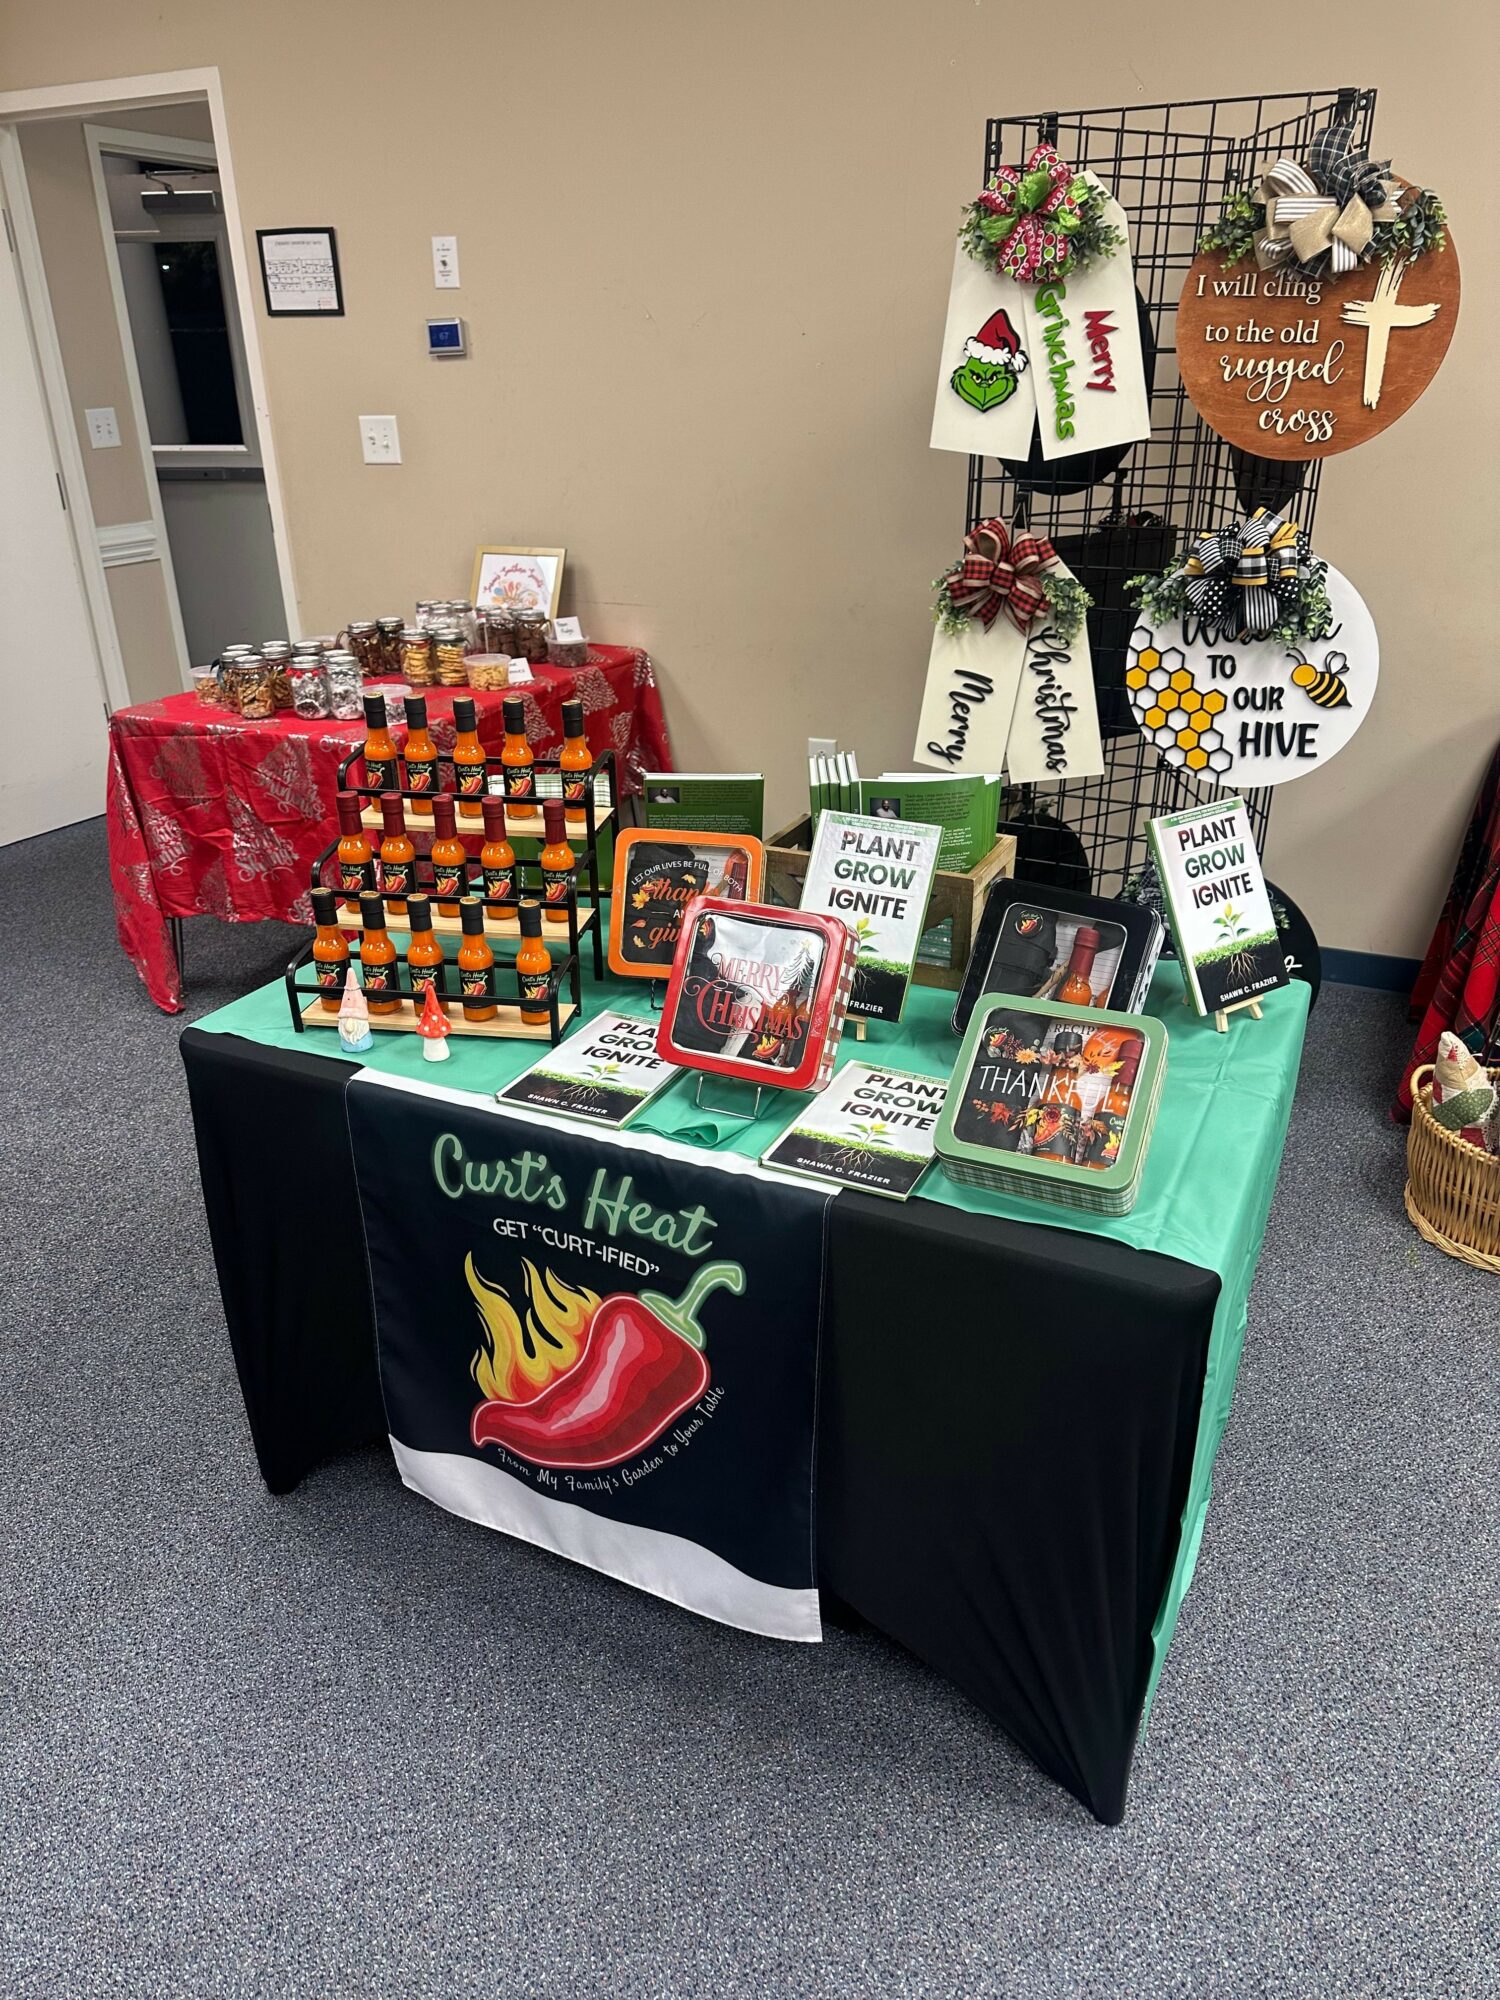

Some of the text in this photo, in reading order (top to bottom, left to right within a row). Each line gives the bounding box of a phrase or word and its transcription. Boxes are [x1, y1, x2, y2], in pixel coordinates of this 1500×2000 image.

[1196, 274, 1323, 303] I will cling
[1205, 318, 1319, 342] to the old
[1084, 310, 1119, 392] Merry
[1219, 340, 1344, 403] rugged
[1258, 405, 1338, 443] cross
[1206, 654, 1237, 679] TO
[1028, 625, 1078, 773] Christmas
[1233, 687, 1285, 711] OUR
[926, 669, 995, 765] Merry
[1238, 722, 1320, 759] HIVE
[840, 831, 920, 861] PLANT
[1178, 816, 1236, 851] PLANT
[834, 858, 916, 890] GROW
[1184, 843, 1245, 878] GROW
[631, 873, 644, 886] LET
[644, 864, 661, 876] OUR
[661, 861, 682, 870] LIVES
[694, 862, 711, 873] FULL
[723, 875, 743, 893] BOTH
[1192, 872, 1254, 909] IGNITE
[828, 887, 907, 920] IGNITE
[711, 953, 789, 998] MERRY
[1219, 975, 1279, 1002] SHAWN C. FRAZIER
[684, 976, 804, 1043] CHRISTMAS
[849, 1000, 884, 1014] FRAZIER
[599, 1034, 657, 1053] GRO
[612, 1022, 658, 1038] PLA
[1054, 1024, 1096, 1035] RECIP
[582, 1046, 664, 1069] IGNITE
[527, 1093, 559, 1104] SHAWN
[571, 1103, 608, 1115] FRAZIER
[853, 1087, 944, 1115] GROW
[979, 1065, 1114, 1113] THANKFUL
[840, 1101, 935, 1131] IGNITE
[796, 1157, 891, 1185] SHAWN C. FRAZIER
[434, 1133, 718, 1256] Curt's Heat
[493, 1218, 528, 1239] GET
[497, 1386, 725, 1495] From My Family's Garden to Your Table
